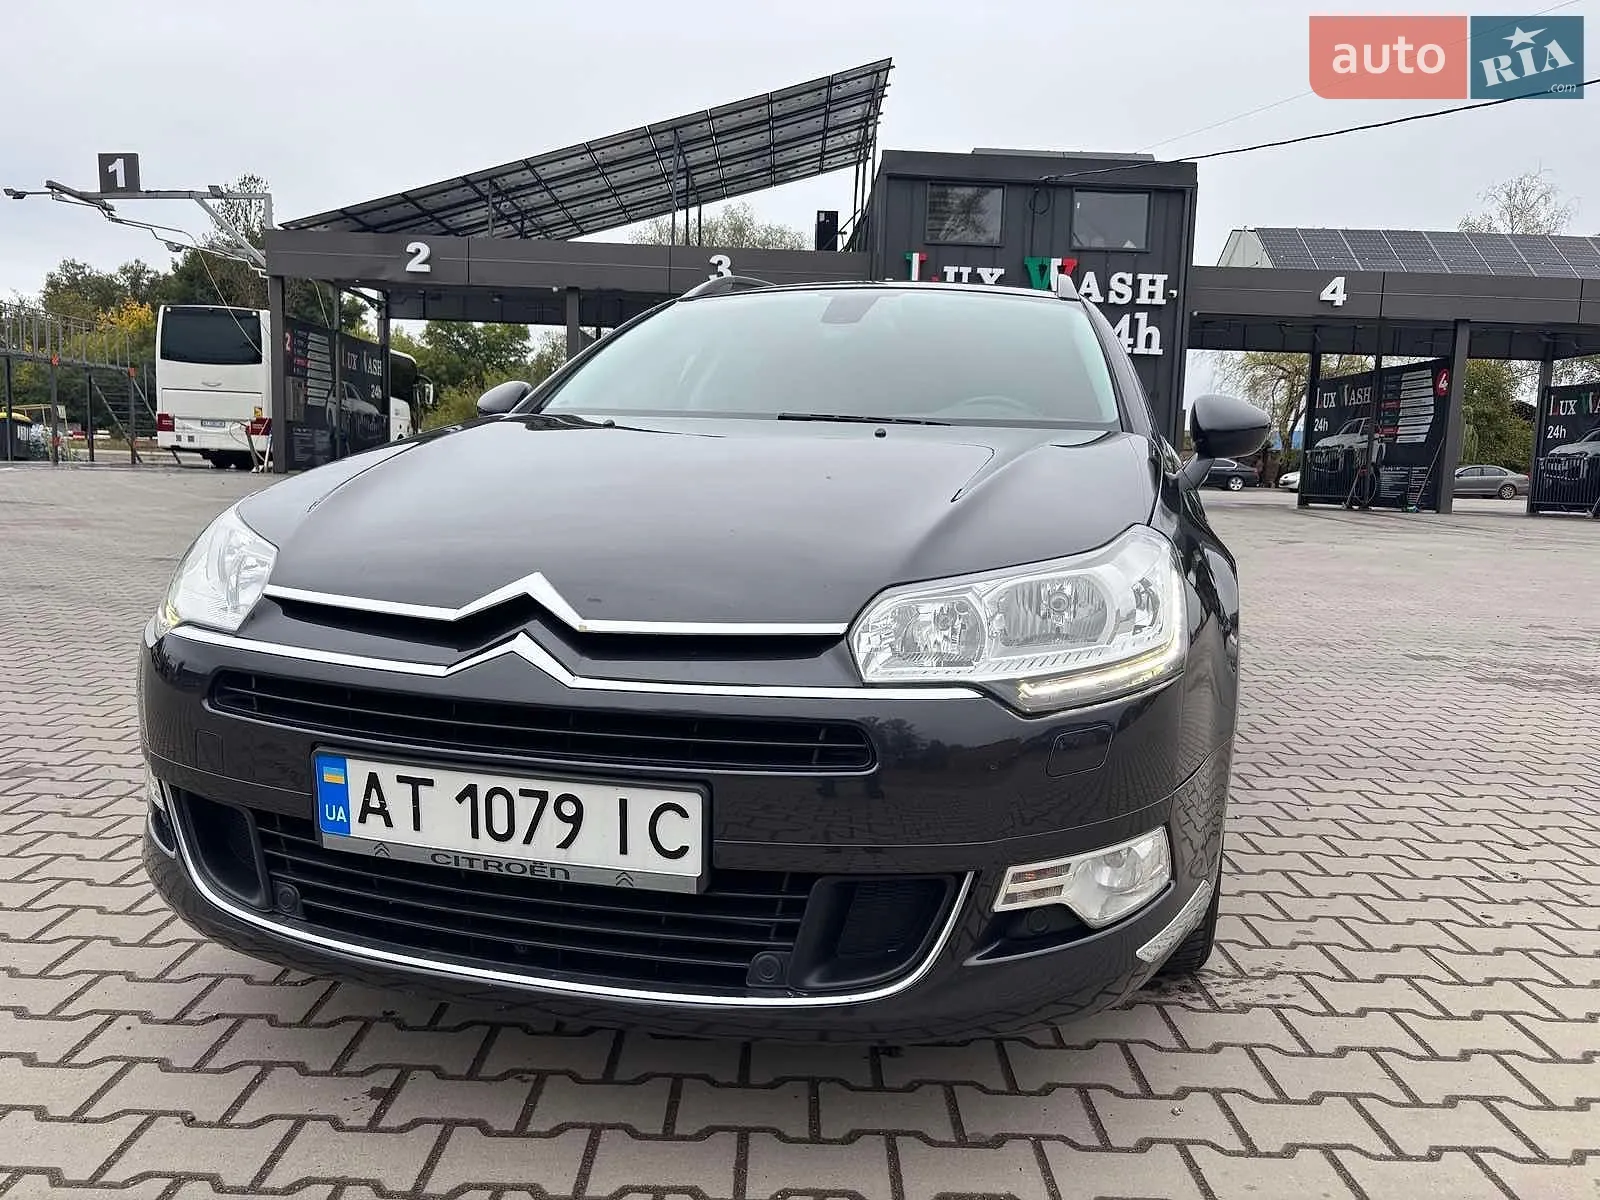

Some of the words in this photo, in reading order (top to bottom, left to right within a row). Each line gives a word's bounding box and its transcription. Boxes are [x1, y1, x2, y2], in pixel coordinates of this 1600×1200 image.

[107, 158, 126, 188] 1
[405, 242, 431, 273] 2
[709, 254, 732, 281] 3
[1024, 257, 1169, 305] WASH
[1319, 276, 1347, 306] 4
[1112, 312, 1163, 355] 4h
[1438, 372, 1449, 391] 4
[1548, 394, 1578, 416] LUX
[1313, 417, 1328, 432] 24h
[1546, 424, 1567, 439] 24h
[325, 803, 347, 823] UA
[358, 771, 435, 832] AT
[455, 783, 584, 849] 1079
[618, 797, 690, 860] IC
[430, 852, 570, 881] CITROËN
